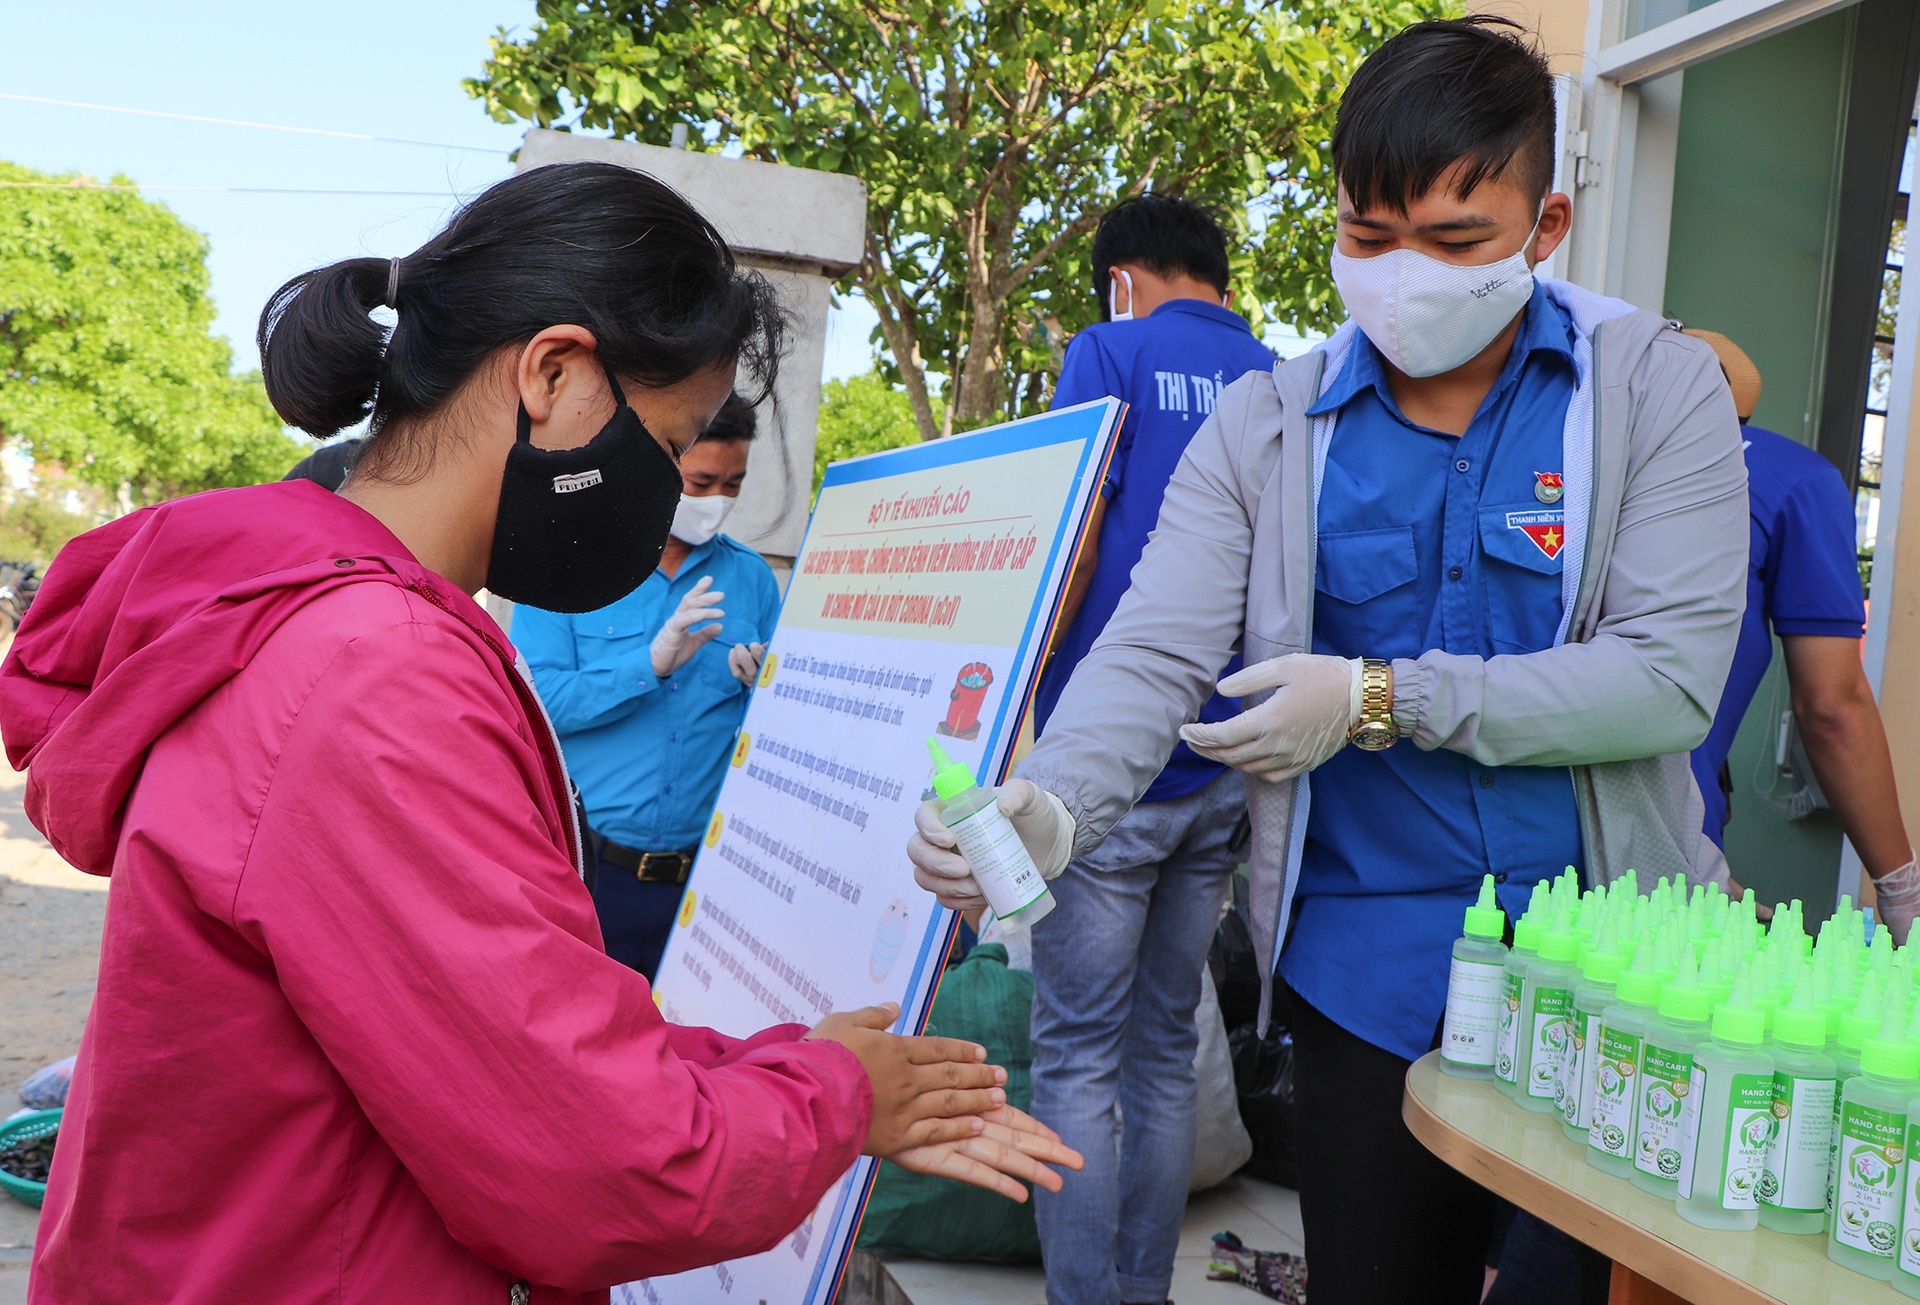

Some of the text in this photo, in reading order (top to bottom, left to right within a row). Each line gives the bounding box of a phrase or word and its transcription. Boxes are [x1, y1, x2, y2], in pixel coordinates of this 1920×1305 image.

[1155, 371, 1189, 421] THỊ
[867, 485, 971, 529] BỘ Y TẾ KHUYẾN CÁO
[1510, 515, 1537, 524] THANH
[1537, 512, 1555, 522] NIÊN
[905, 538, 931, 580] BỆNH
[926, 537, 952, 573] VIÊM
[945, 534, 981, 572] ĐƯỜNG
[975, 532, 995, 571] HÔ
[989, 526, 1015, 571] HẤP
[1010, 524, 1037, 570] CẤP
[877, 594, 890, 621] VI
[899, 594, 934, 624] CORONA
[928, 594, 962, 630] (nCoV)
[1613, 1042, 1632, 1053] CARE
[1621, 1062, 1633, 1072] VIP
[1646, 1056, 1687, 1072] HAND CARE
[1675, 1083, 1688, 1093] VIP
[1772, 1082, 1786, 1093] ARE
[1775, 1102, 1786, 1114] VIP
[1645, 1113, 1679, 1127] HAND CARE
[1848, 1116, 1902, 1135] HAND CARE
[1656, 1124, 1663, 1132] in
[1888, 1147, 1903, 1159] VIP
[1848, 1180, 1894, 1198] HAND CARE
[1856, 1191, 1882, 1205] 2 in 1
[1868, 1221, 1896, 1234] NATURAL
